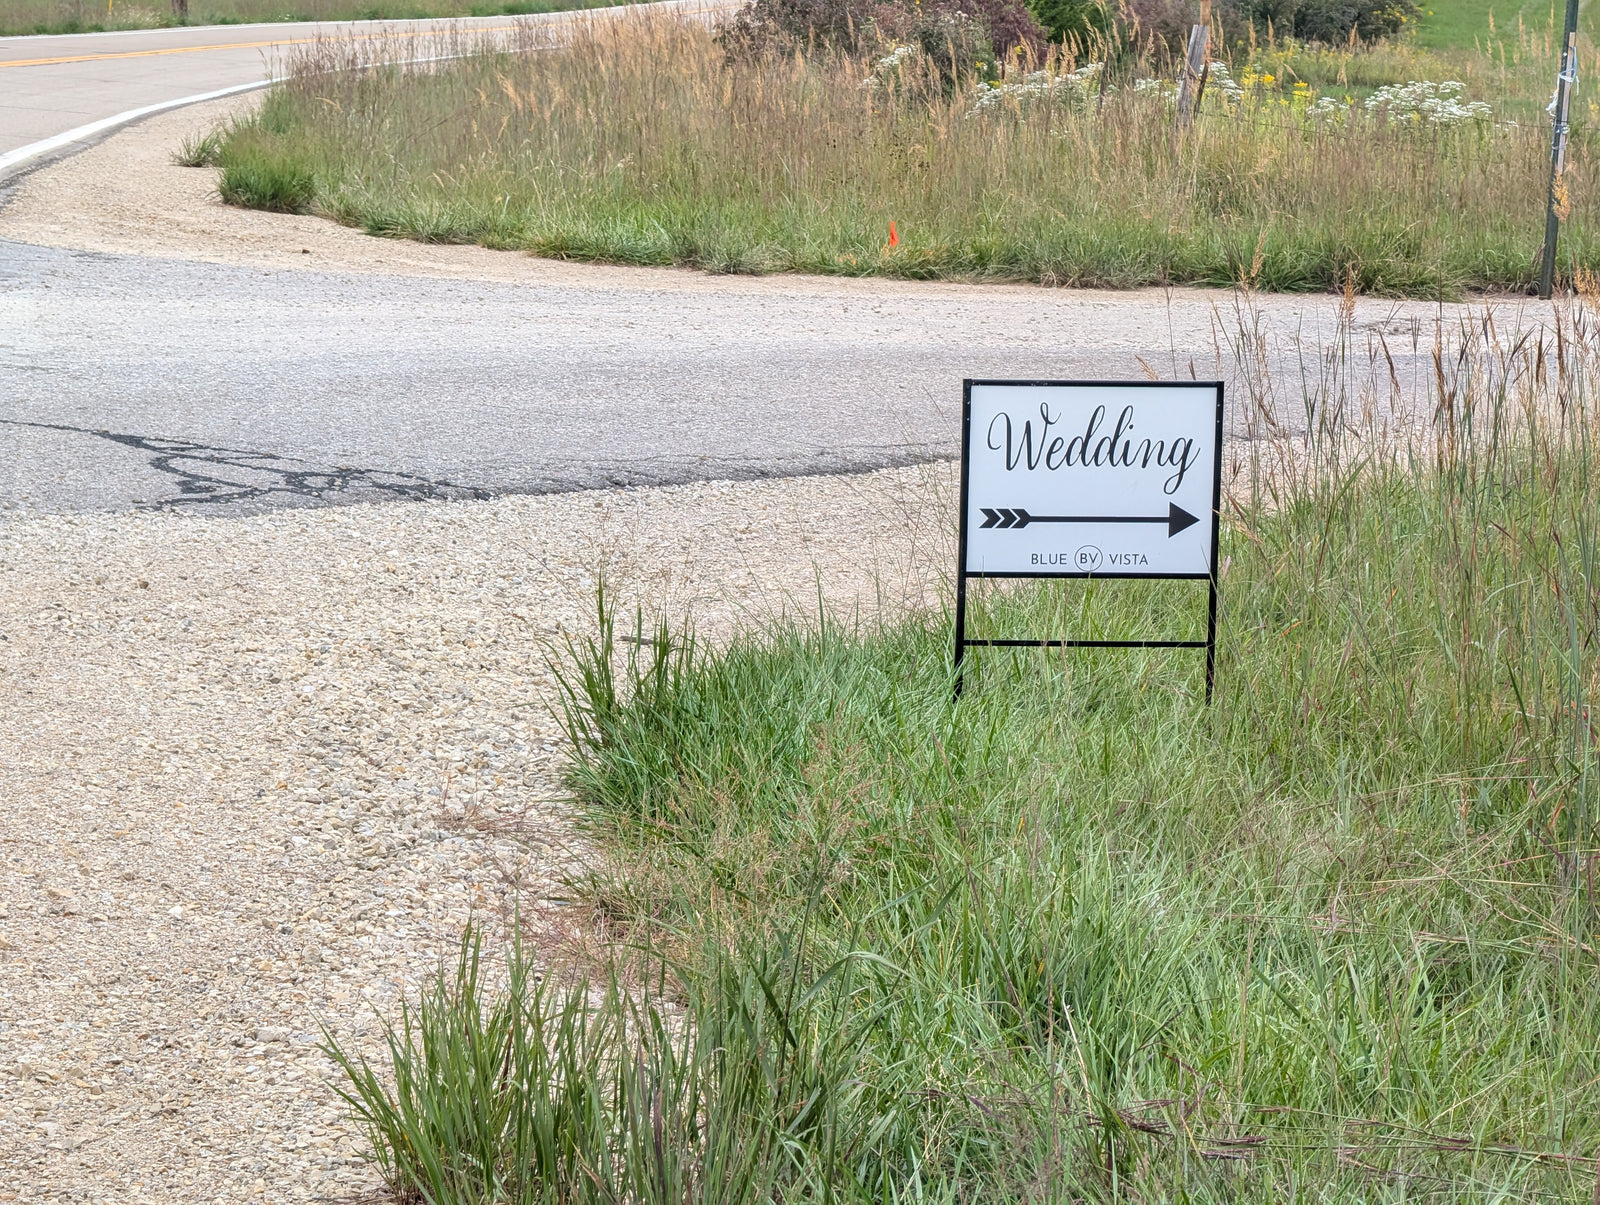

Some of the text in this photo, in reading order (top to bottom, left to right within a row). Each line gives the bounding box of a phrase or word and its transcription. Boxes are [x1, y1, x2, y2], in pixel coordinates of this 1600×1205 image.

[987, 401, 1201, 495] Wedding
[1031, 552, 1149, 566] BLUE BV VISTA
